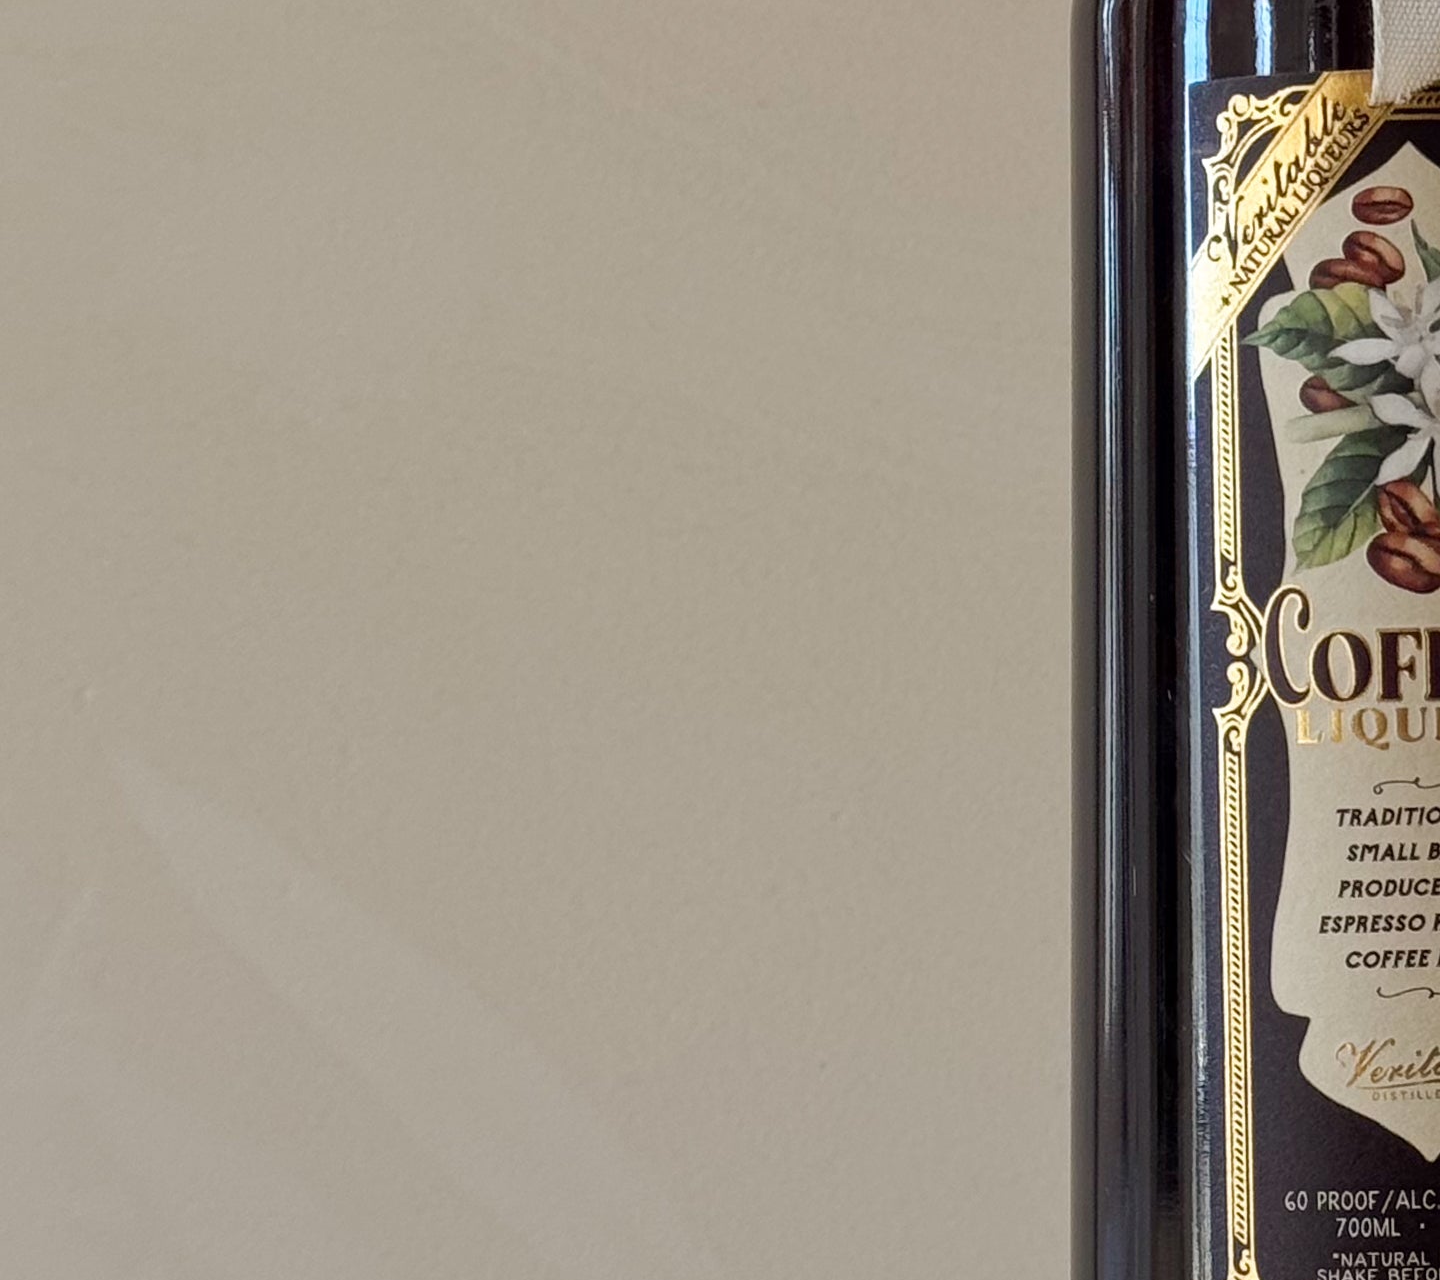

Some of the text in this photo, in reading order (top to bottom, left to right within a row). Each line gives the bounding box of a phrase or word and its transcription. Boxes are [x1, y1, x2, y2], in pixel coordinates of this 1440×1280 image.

[1207, 92, 1347, 269] Veritable
[1229, 107, 1370, 294] NATURAL LIQUEURS
[1346, 843, 1420, 862] SMALL
[1319, 914, 1426, 934] ESPRESSO
[1345, 950, 1431, 969] COFFEE
[1284, 1190, 1308, 1211] 60
[1336, 1217, 1401, 1238] 700ML
